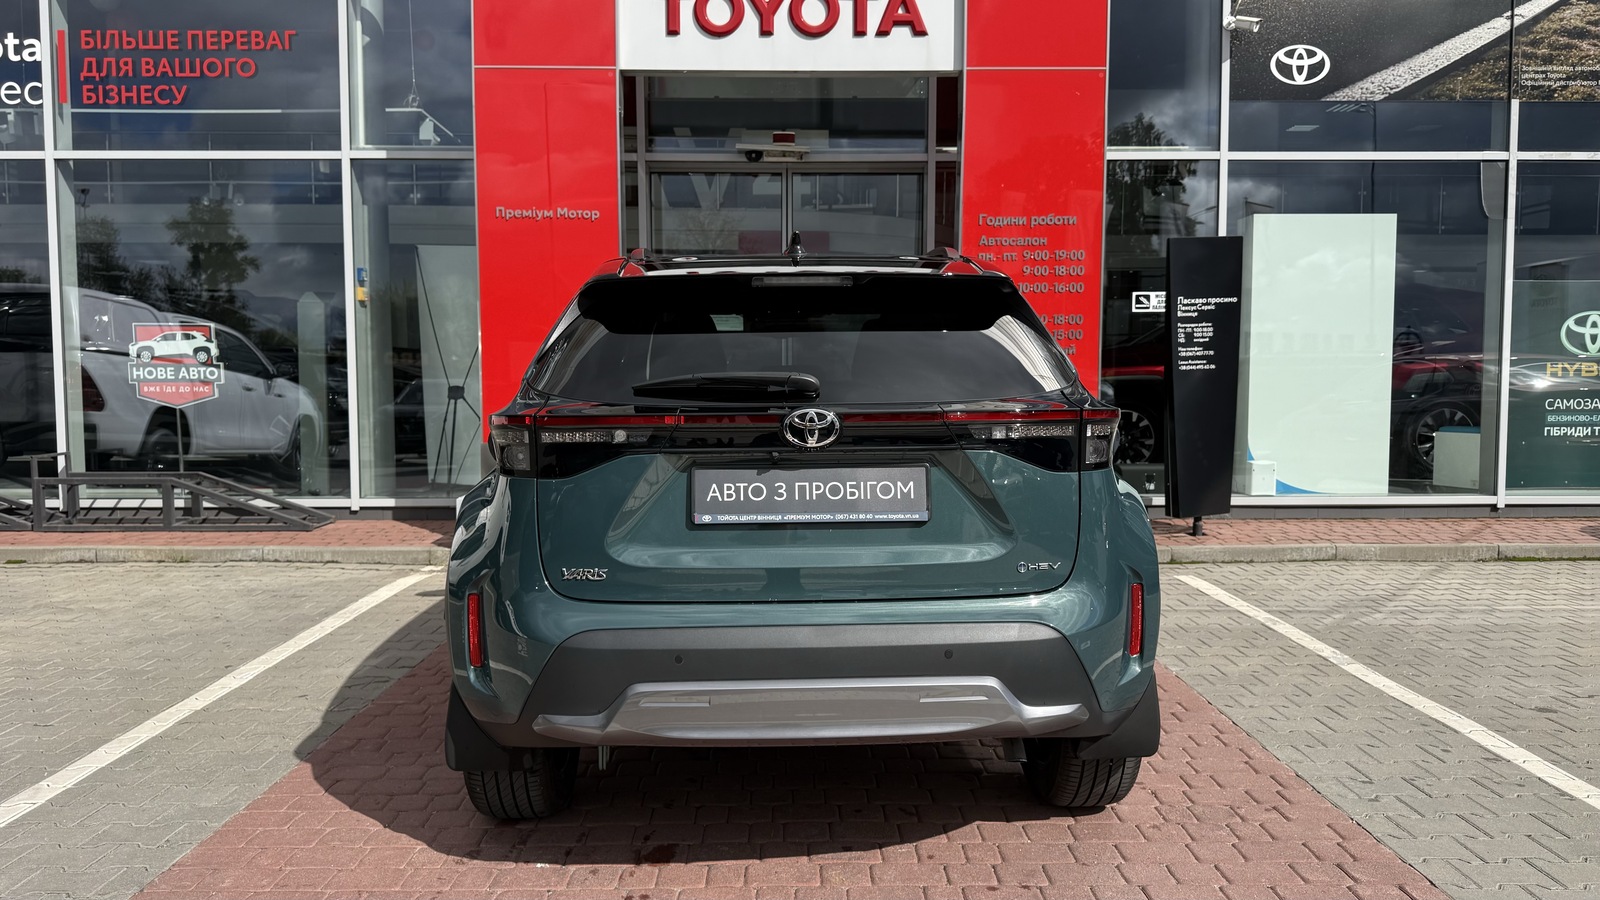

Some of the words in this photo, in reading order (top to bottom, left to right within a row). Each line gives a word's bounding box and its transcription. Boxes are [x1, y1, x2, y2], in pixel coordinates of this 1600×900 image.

[665, 0, 928, 37] TOYOTA
[80, 29, 180, 50] БІЛЬШЕ
[187, 30, 296, 50] ПЕРЕВАГ
[80, 57, 133, 81] ДЛЯ
[141, 57, 257, 78] ВАШОГО
[82, 85, 188, 105] БІЗНЕСУ
[495, 206, 554, 221] Преміум
[557, 206, 600, 221] Мотор
[978, 214, 1026, 228] Години
[1030, 213, 1077, 229] роботи
[978, 235, 1047, 247] Автосалон
[1022, 250, 1085, 262] 9:00-19:00
[1022, 265, 1085, 277] 9:00-18:00
[1178, 296, 1207, 304] Ласкаво
[1040, 314, 1084, 325] 0-18:00
[1052, 330, 1083, 341] 15:00
[133, 367, 175, 379] НОВЕ
[178, 367, 218, 380] АВТО
[1546, 362, 1600, 377] HYB
[143, 385, 160, 393] ВЖЕ
[163, 385, 176, 393] ЇДЕ
[1545, 398, 1600, 410] САМОЗА
[1544, 427, 1591, 437] ГІБРИДИ
[706, 482, 767, 502] АВТО
[774, 482, 787, 501] З
[795, 480, 914, 500] ПРОБІГОМ
[1028, 562, 1061, 571] HEV
[561, 567, 608, 580] YARIS
